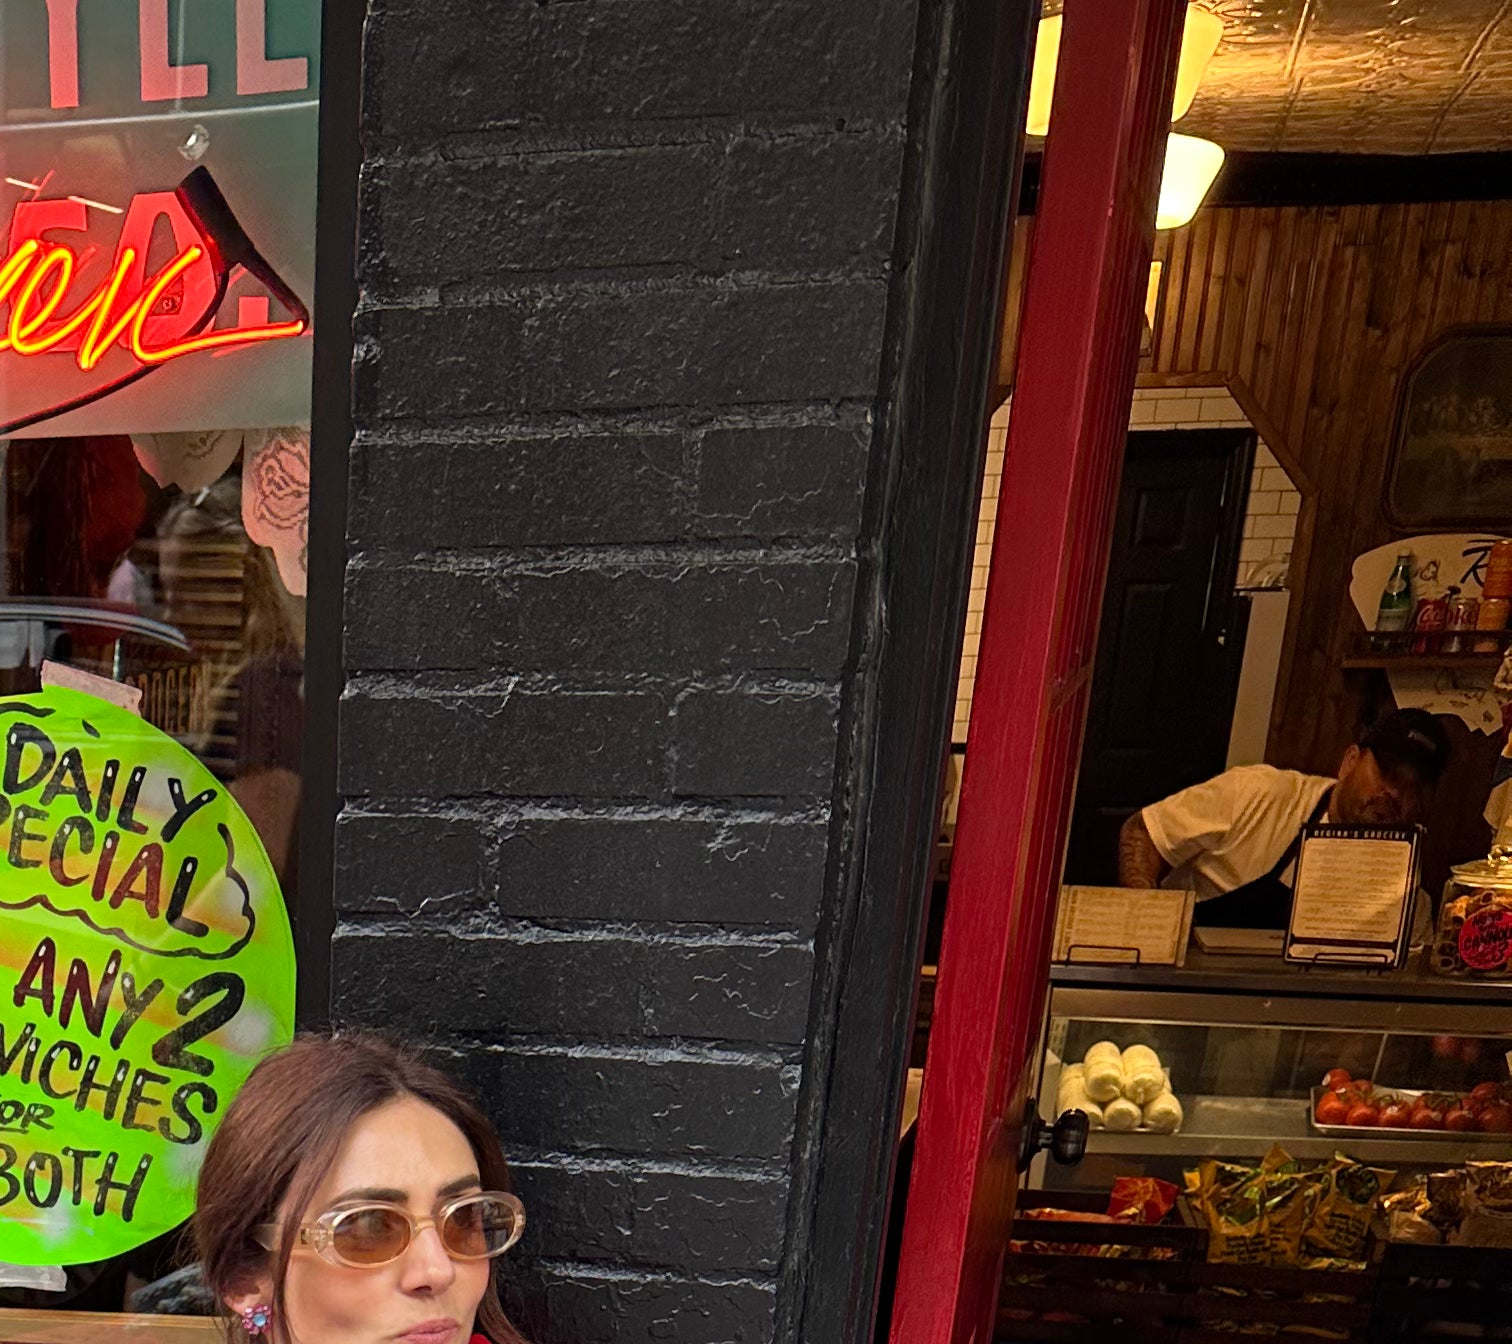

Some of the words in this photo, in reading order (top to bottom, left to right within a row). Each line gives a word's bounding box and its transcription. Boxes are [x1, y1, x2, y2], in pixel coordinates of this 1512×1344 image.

[2, 722, 217, 843] DAILY
[13, 936, 165, 1051] ANY
[151, 972, 246, 1078] 2
